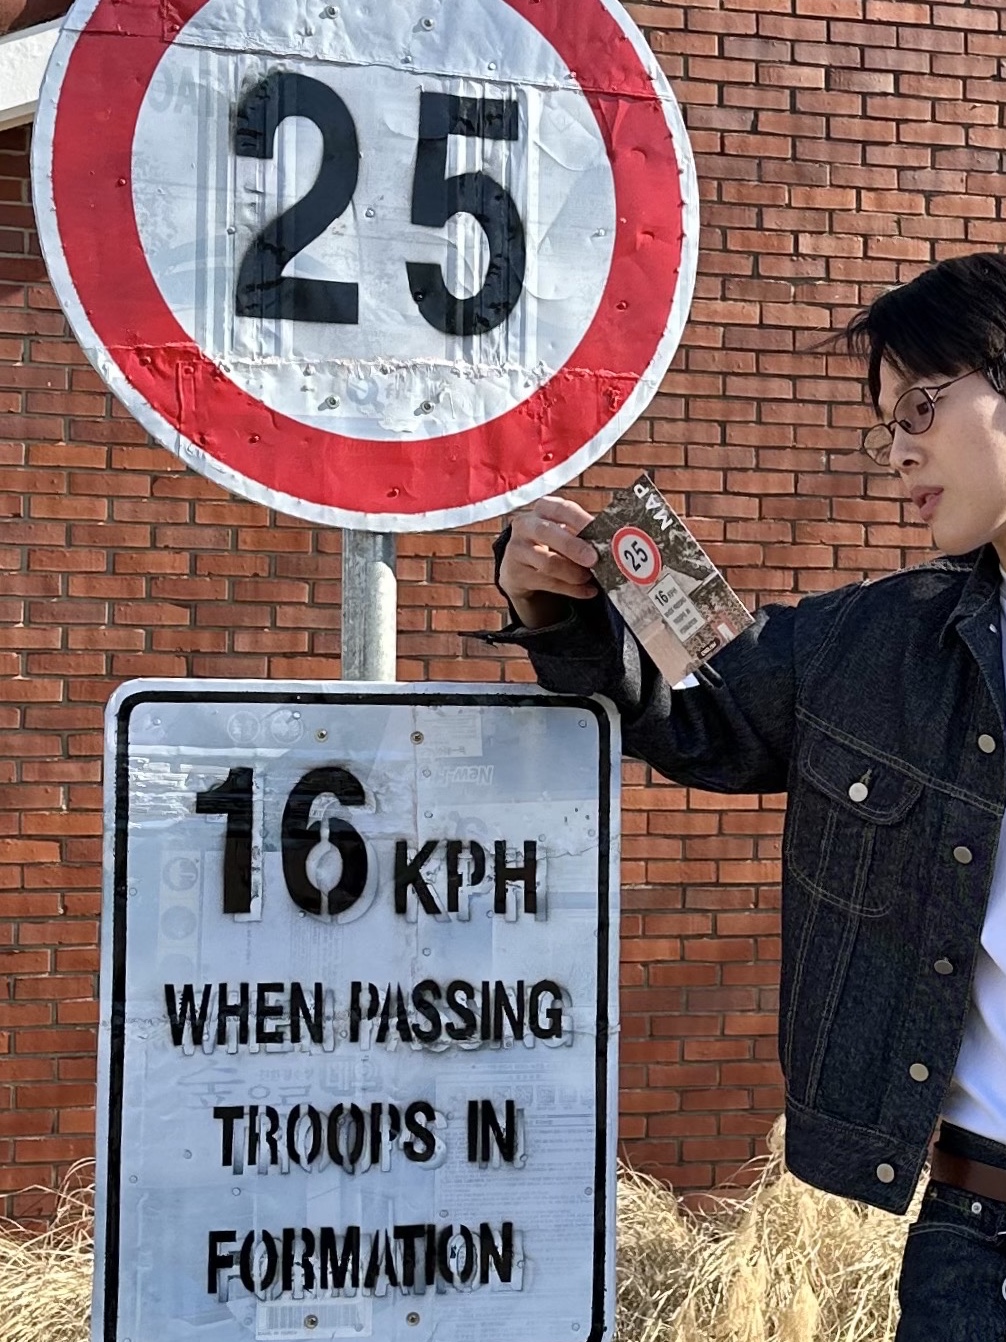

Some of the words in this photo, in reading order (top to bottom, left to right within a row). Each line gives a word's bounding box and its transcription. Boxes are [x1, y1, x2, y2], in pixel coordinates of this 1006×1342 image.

[234, 70, 526, 337] 25
[633, 483, 674, 531] MAP
[624, 540, 648, 572] 25
[654, 589, 670, 606] 16
[196, 766, 367, 916] 16
[394, 838, 537, 915] KPH
[165, 982, 324, 1048] WHEN
[349, 980, 563, 1044] PASSING
[213, 1100, 436, 1167] TROOPS
[467, 1099, 517, 1163] IN
[207, 1222, 514, 1294] FORMATION
